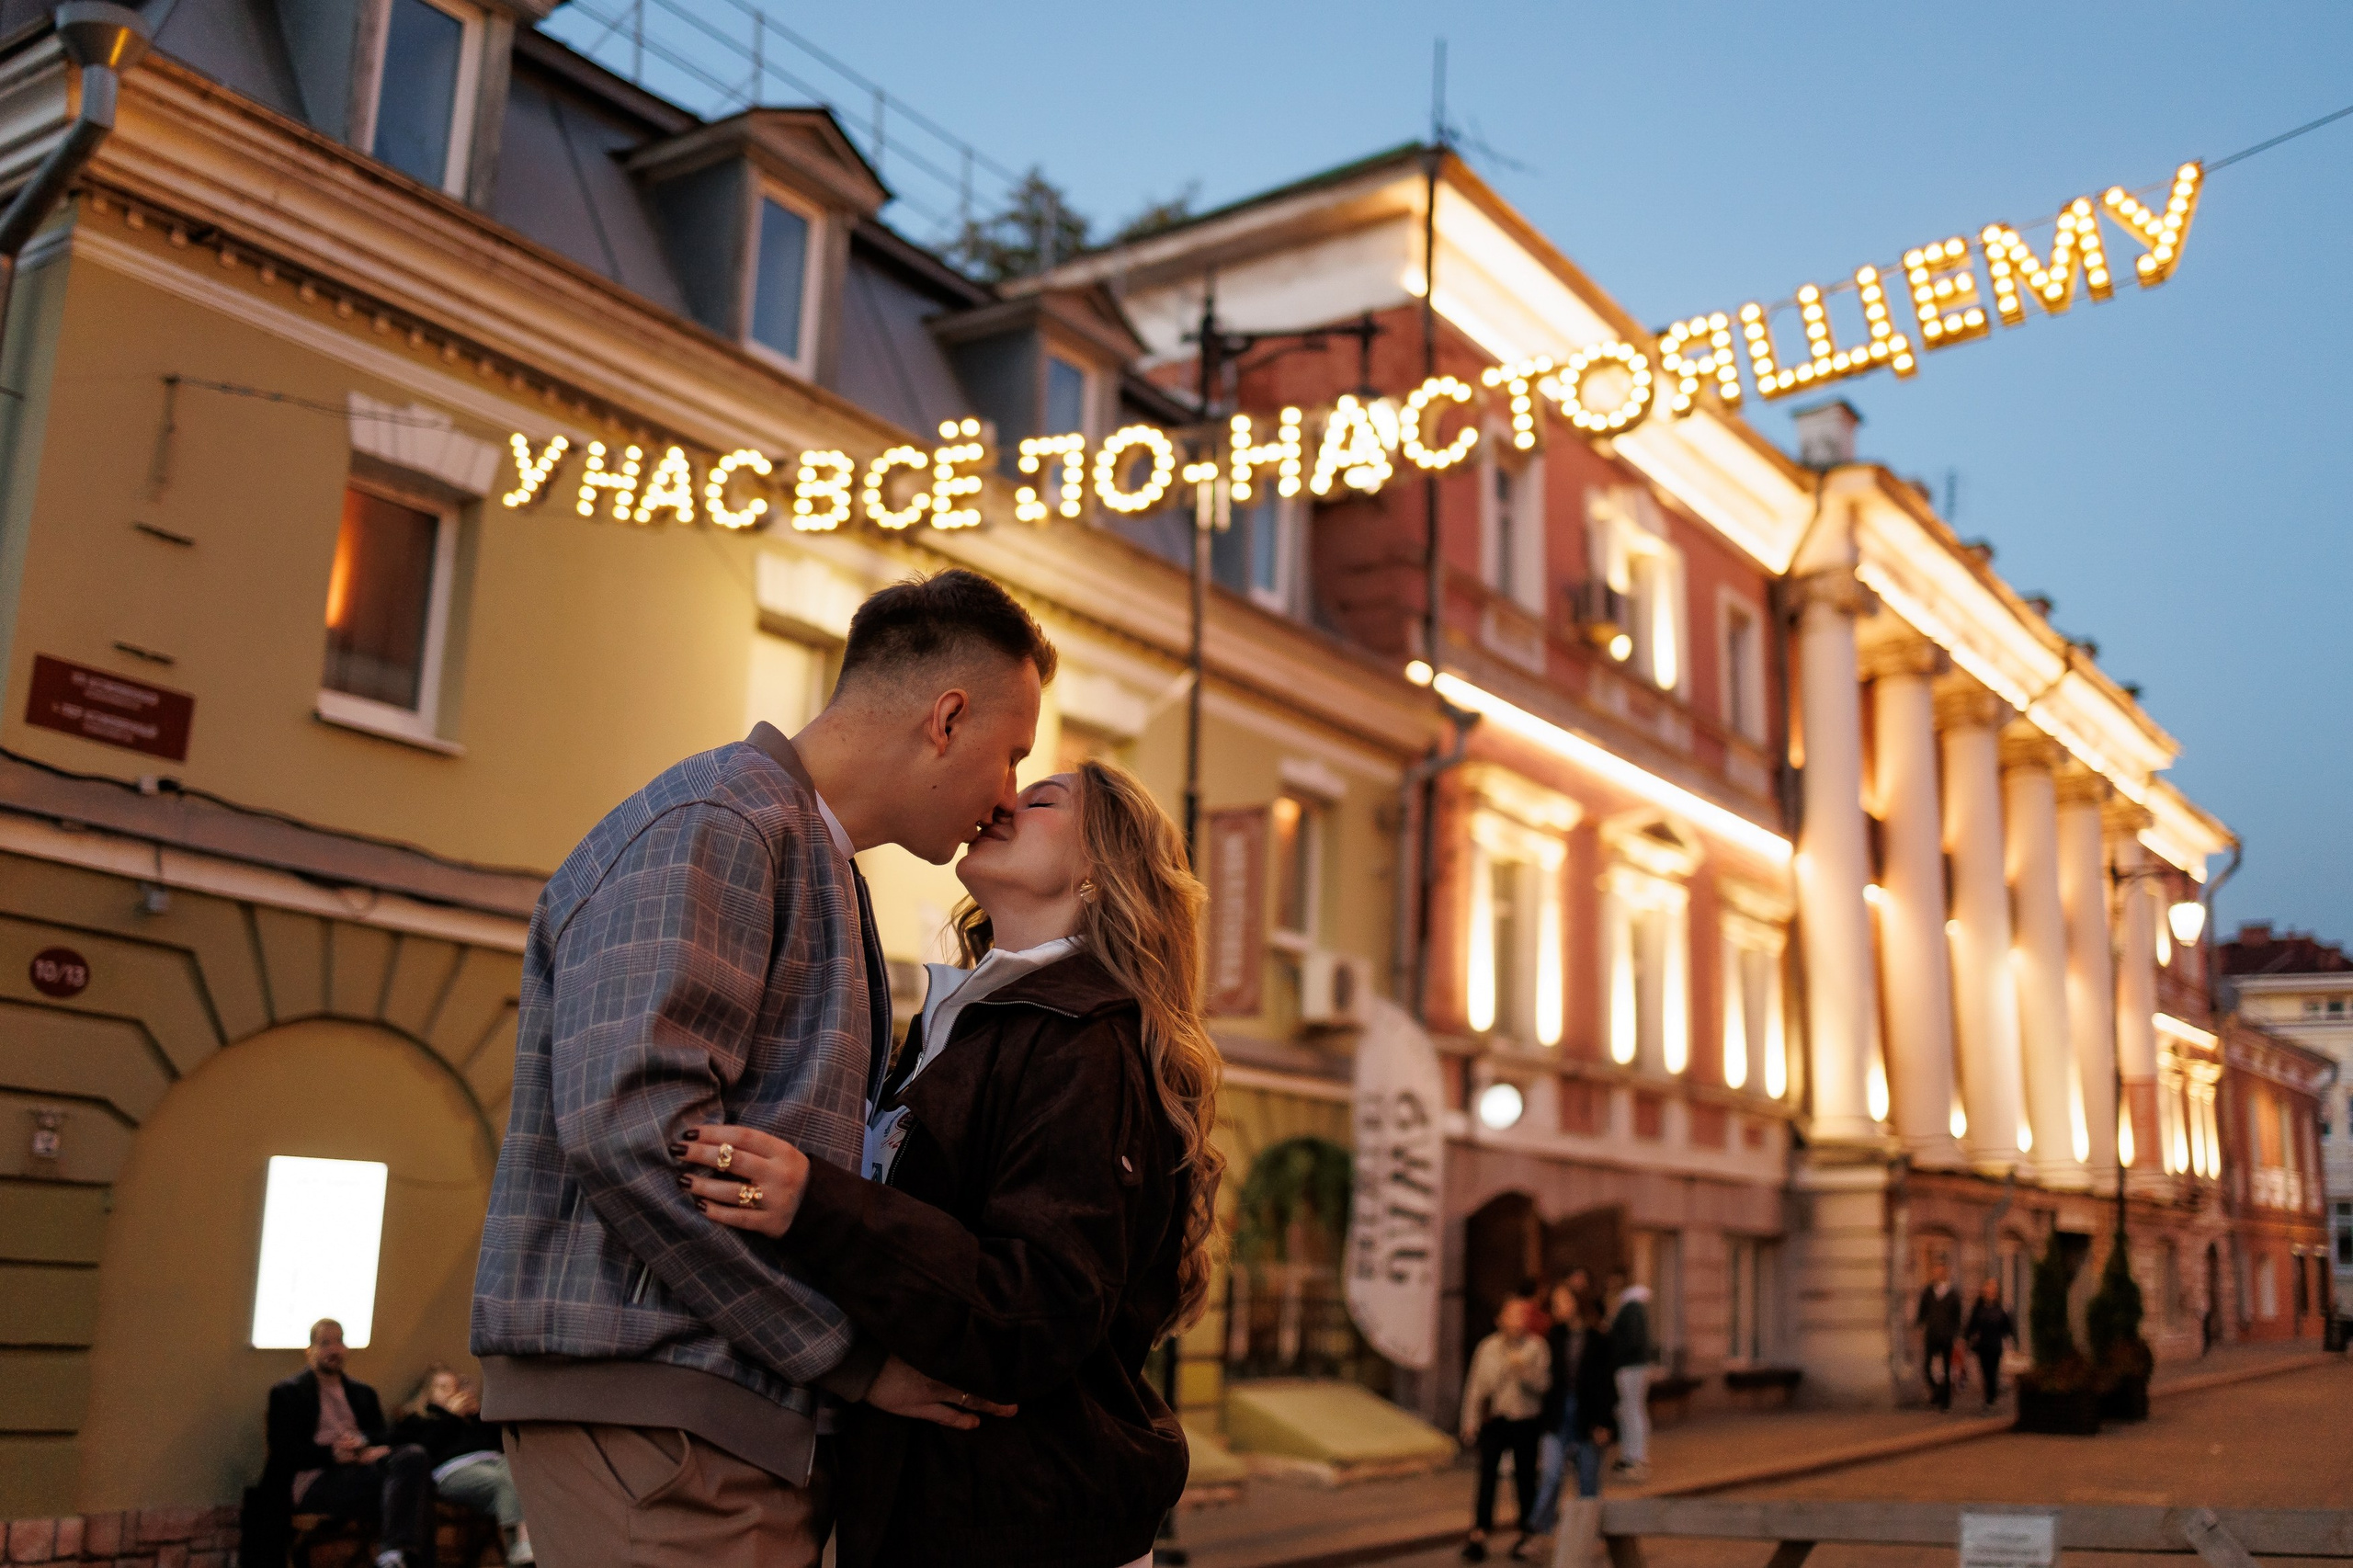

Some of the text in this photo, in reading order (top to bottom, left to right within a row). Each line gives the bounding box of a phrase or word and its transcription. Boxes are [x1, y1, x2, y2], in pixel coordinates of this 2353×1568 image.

[502, 158, 2205, 532] У НАС ВСЁ ПО-НАСТОЯЩЕМУ
